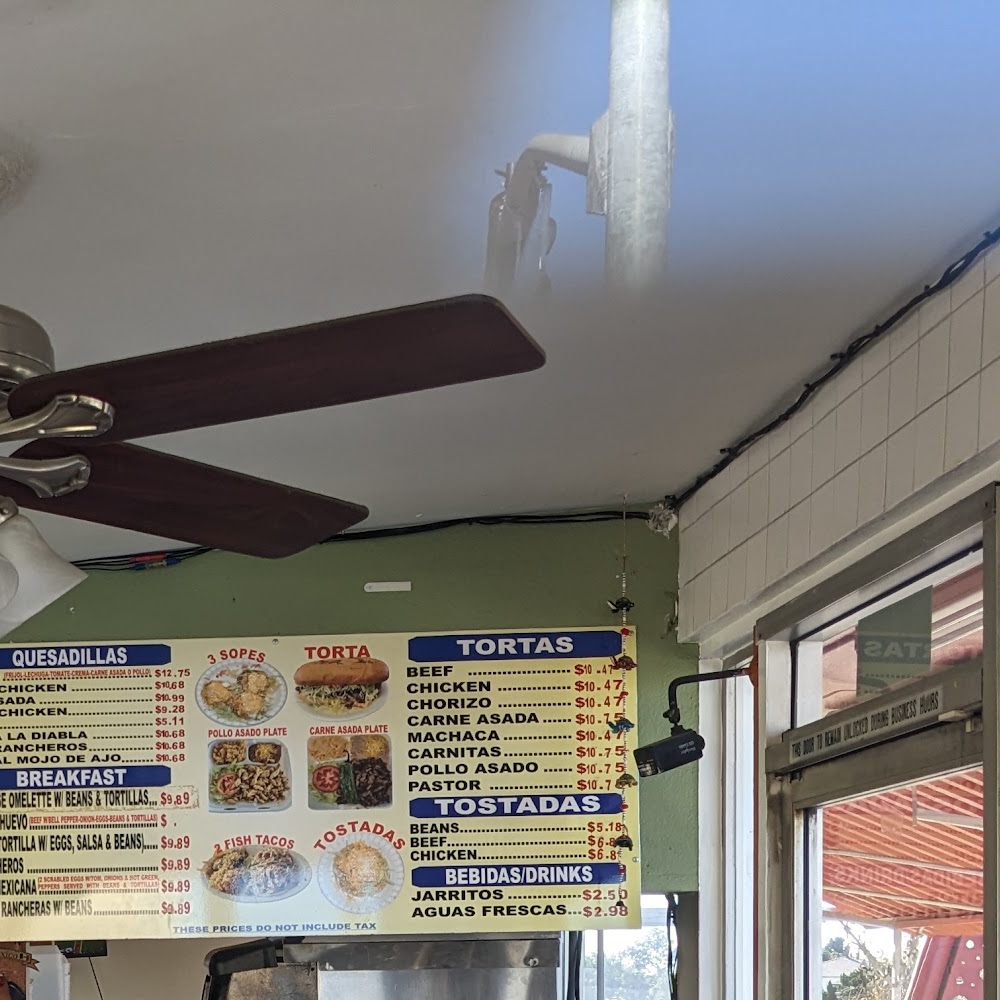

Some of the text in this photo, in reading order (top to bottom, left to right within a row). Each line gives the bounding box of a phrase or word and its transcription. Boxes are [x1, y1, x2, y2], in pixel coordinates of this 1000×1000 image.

[304, 645, 371, 659] TORTA
[456, 637, 574, 655] TORTAS
[12, 647, 128, 668] QUESADILLAS
[207, 649, 266, 664] 3 SOPES
[407, 666, 453, 678] BEEF
[407, 682, 491, 694] CHICKEN
[407, 698, 492, 710] CHORIZO
[0, 707, 68, 717] CHICKEN
[408, 713, 539, 726] CARNE ASADA
[817, 734, 822, 750] TO
[825, 726, 841, 747] REMAIN
[844, 718, 868, 740] UNLOCKED
[871, 710, 889, 731] DURING
[891, 700, 916, 724] BUSINESS
[920, 691, 938, 714] HOURS
[208, 728, 287, 738] POLLO ASADO PLATE
[310, 725, 388, 735] CARNE ASADA PLATE
[408, 731, 500, 742] MACHACA
[408, 747, 501, 759] CARNITAS
[16, 769, 127, 787] BREAKFAST
[9, 791, 51, 808] OMELETTE
[434, 795, 600, 816] TOSTADAS
[410, 823, 459, 834] BEANS
[224, 835, 295, 849] FISH TACOS
[313, 821, 405, 850] TOSTADAS
[410, 850, 477, 861] CHICKEN
[445, 866, 592, 885] BEBIDAS/DRINKS
[412, 890, 503, 901] JARRITOS
[412, 904, 566, 918] AGUAS FRESCAS
